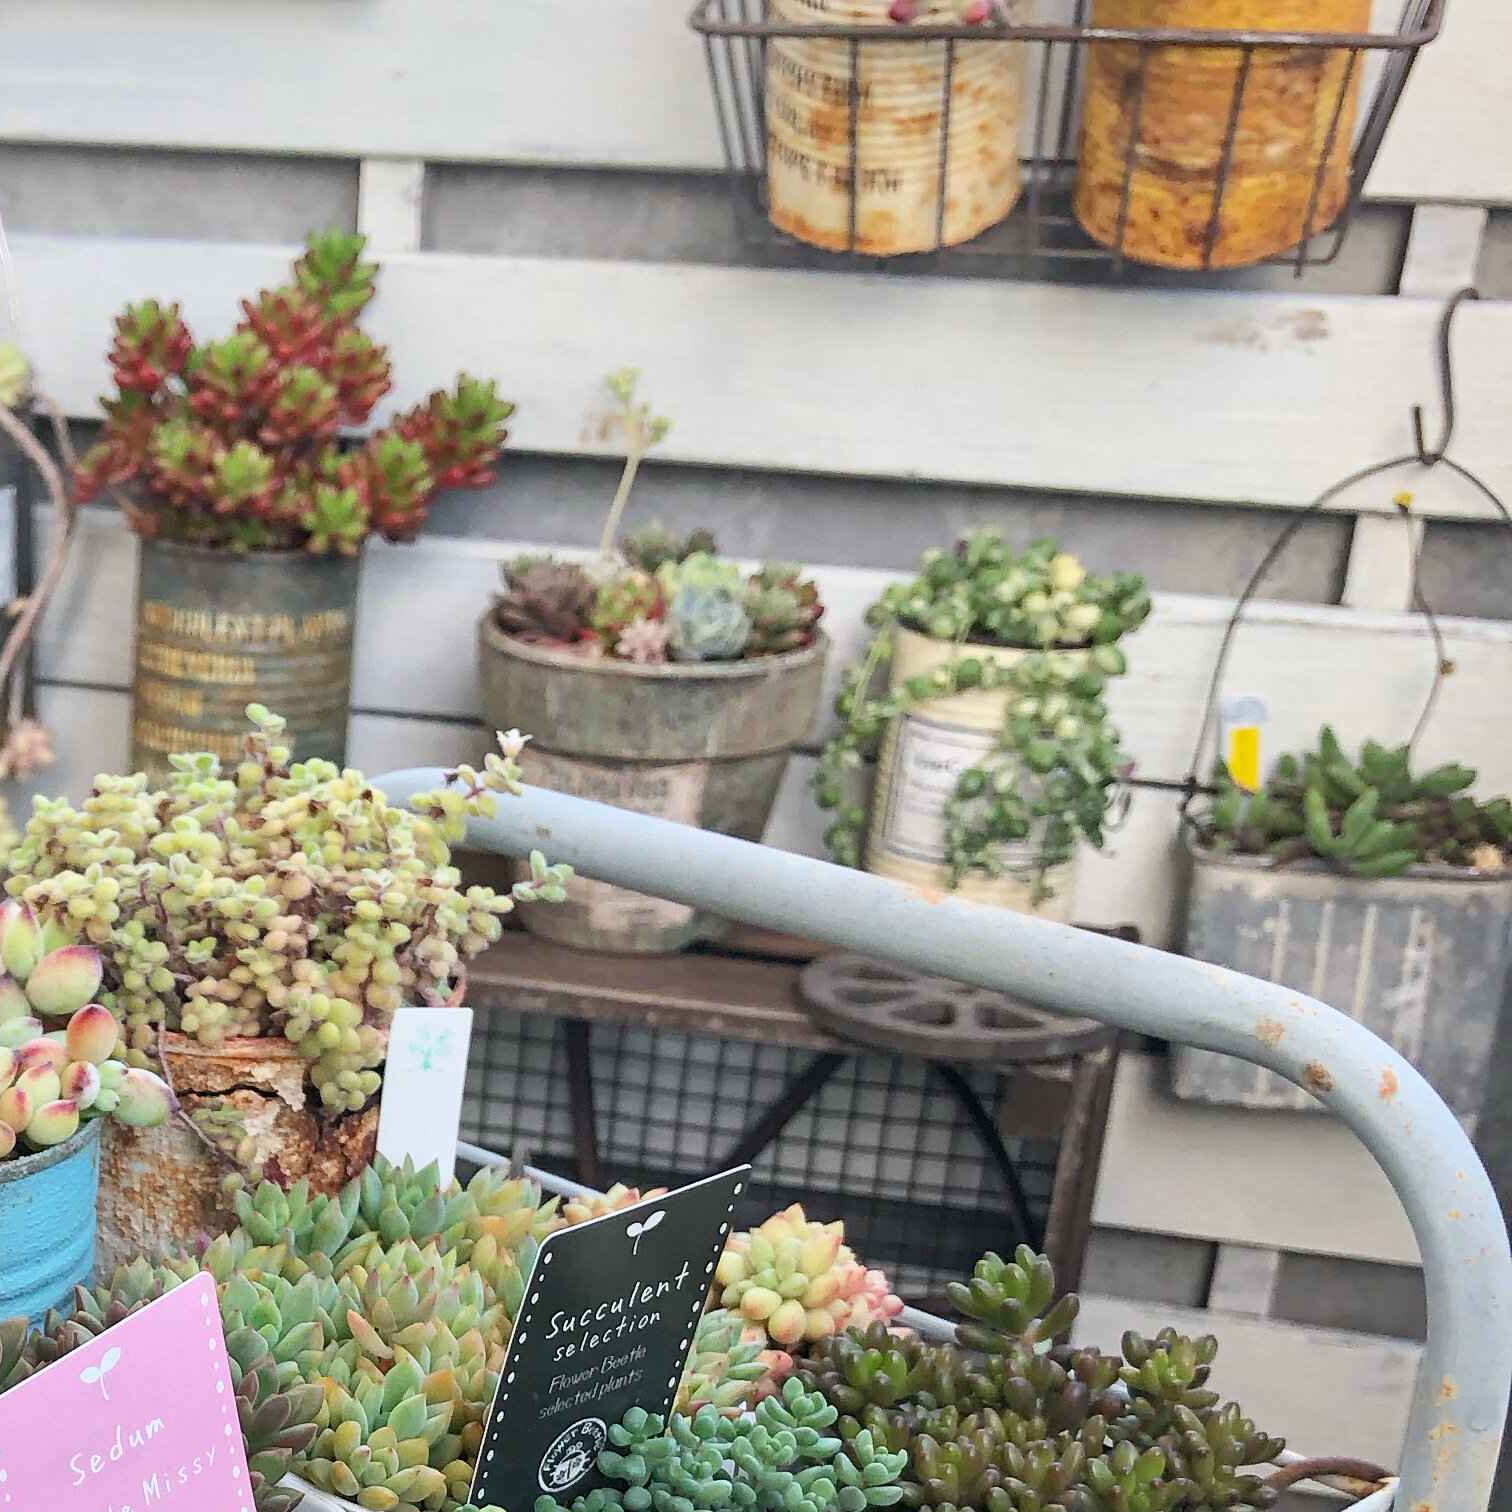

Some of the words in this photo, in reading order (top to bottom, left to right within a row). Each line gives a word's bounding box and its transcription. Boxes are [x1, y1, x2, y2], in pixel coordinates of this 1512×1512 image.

[545, 1261, 690, 1340] Succulent
[553, 1311, 661, 1362] selection
[548, 1365, 599, 1395] Flower
[69, 1416, 166, 1487] Sedum
[142, 1446, 217, 1506] Missy
